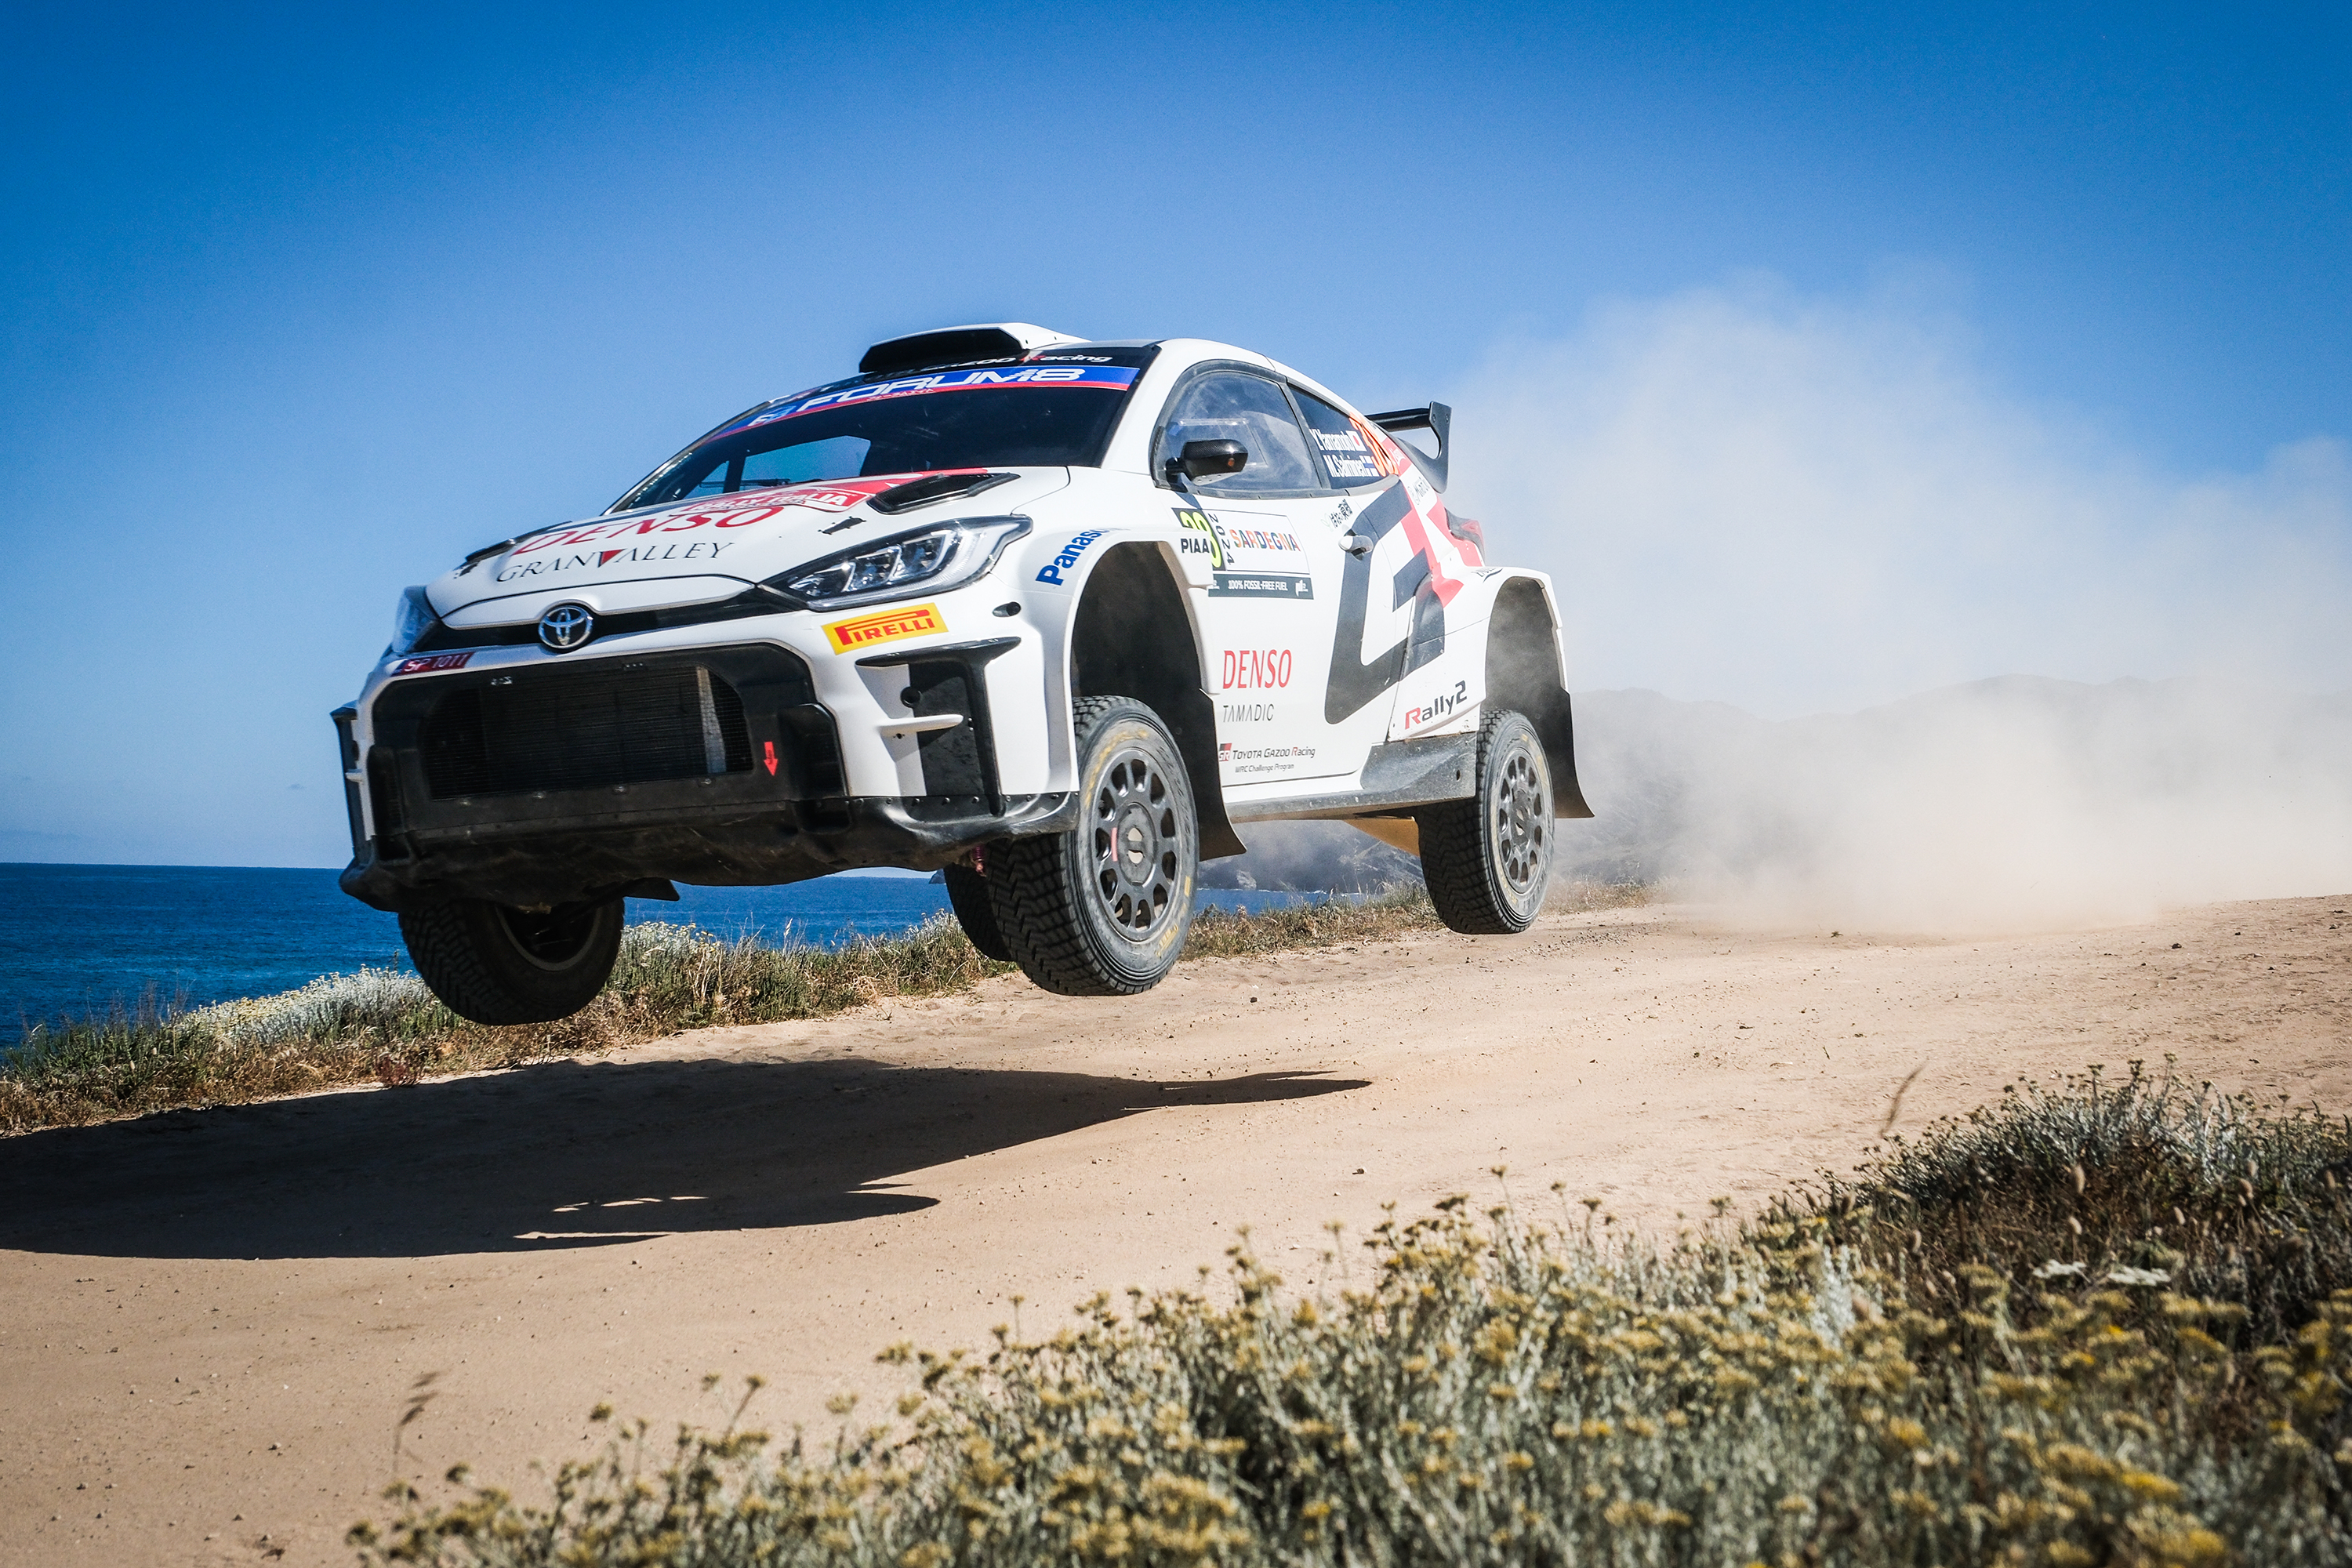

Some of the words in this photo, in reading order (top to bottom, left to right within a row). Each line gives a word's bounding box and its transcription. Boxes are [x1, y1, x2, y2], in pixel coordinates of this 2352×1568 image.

[797, 368, 1086, 412] FORUM8
[511, 506, 785, 557] DENSO
[1180, 538, 1210, 554] PIAA
[1207, 513, 1236, 565] 2024
[1229, 529, 1301, 552] SARDEGNA
[1276, 581, 1289, 591] FUEL
[834, 609, 935, 646] PIRELLI
[1222, 649, 1292, 689] DENSO
[1223, 703, 1275, 723] TAMADIC
[1404, 680, 1468, 730] Rally2
[1232, 750, 1262, 760] TOYOTA
[1263, 747, 1290, 758] GAZOO
[1290, 746, 1316, 759] Racing
[1248, 764, 1274, 774] Challenge
[1273, 762, 1295, 772] Program
